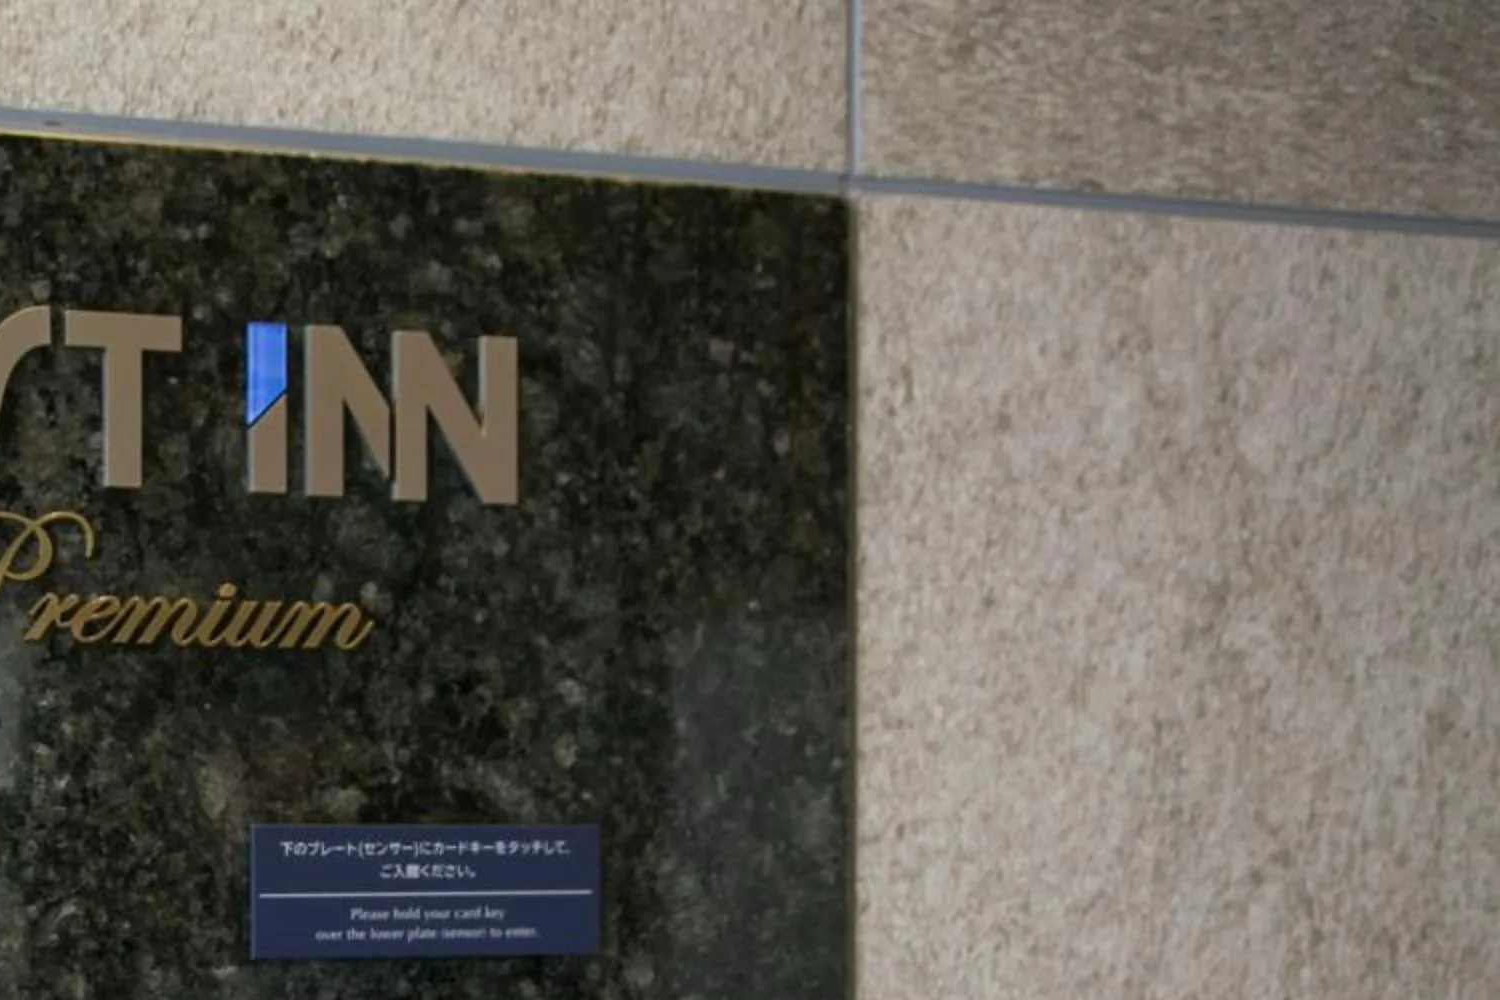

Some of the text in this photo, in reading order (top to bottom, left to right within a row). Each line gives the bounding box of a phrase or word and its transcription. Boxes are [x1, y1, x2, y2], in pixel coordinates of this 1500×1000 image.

[245, 322, 519, 506] INN
[350, 905, 505, 923] Please hold your card key
[346, 927, 367, 941] the
